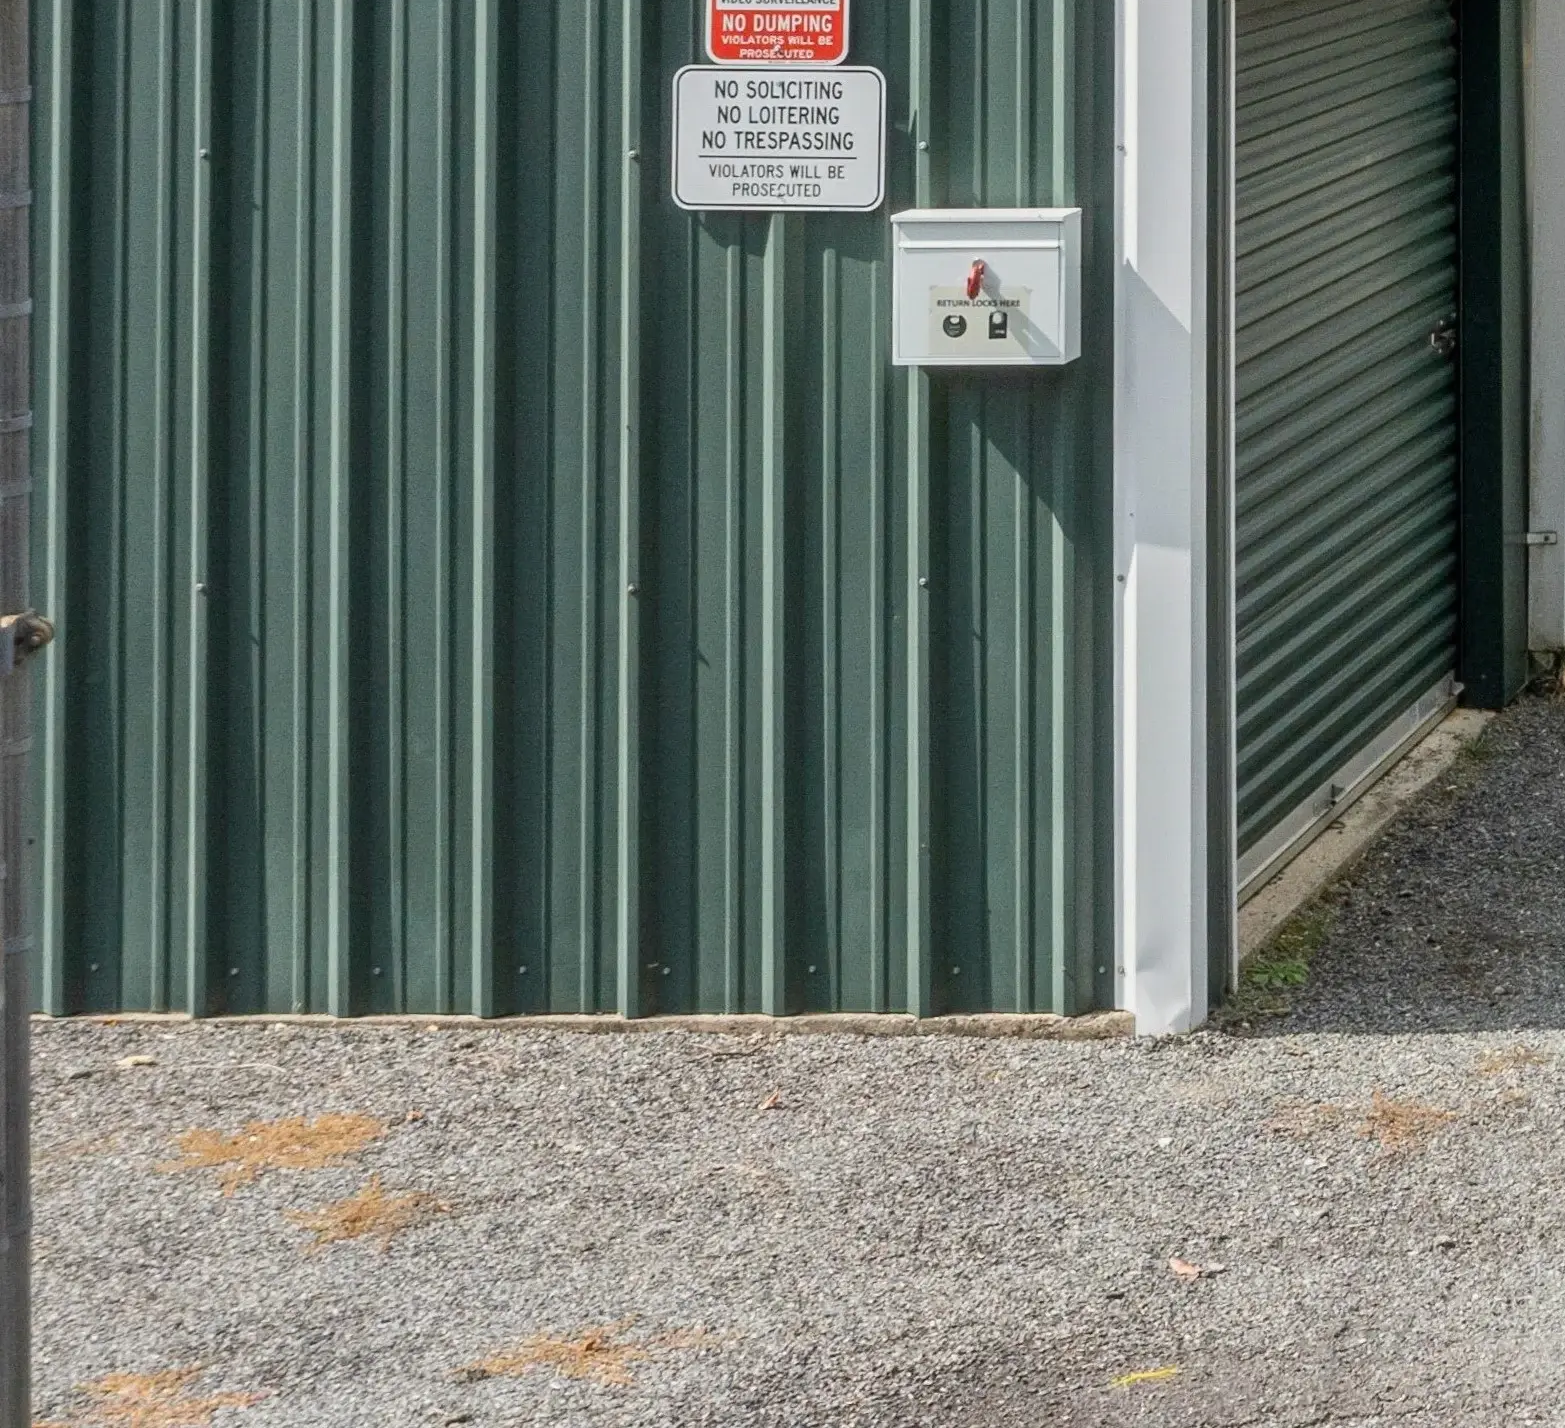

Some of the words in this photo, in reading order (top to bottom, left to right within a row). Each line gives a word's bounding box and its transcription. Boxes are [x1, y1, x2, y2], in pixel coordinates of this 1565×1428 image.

[722, 14, 746, 32] NO
[753, 14, 833, 32] DUMPING
[721, 35, 784, 45] VIOLATORS
[788, 36, 814, 45] WILL
[818, 36, 833, 45] BE
[739, 49, 814, 59] PROSECUTED
[714, 80, 738, 98] NO
[746, 81, 843, 99] SOLICITING
[717, 106, 741, 124] NO
[749, 106, 840, 124] LOITERING
[702, 131, 726, 149] NO
[734, 131, 854, 150] TRESPASSING
[709, 164, 784, 178] VIOLATORS
[789, 165, 822, 178] WILL
[828, 165, 845, 179] BE
[732, 183, 821, 197] PROSECUTED
[937, 299, 970, 307] RETURN
[972, 299, 998, 307] LOCKS
[999, 299, 1020, 307] HERE
